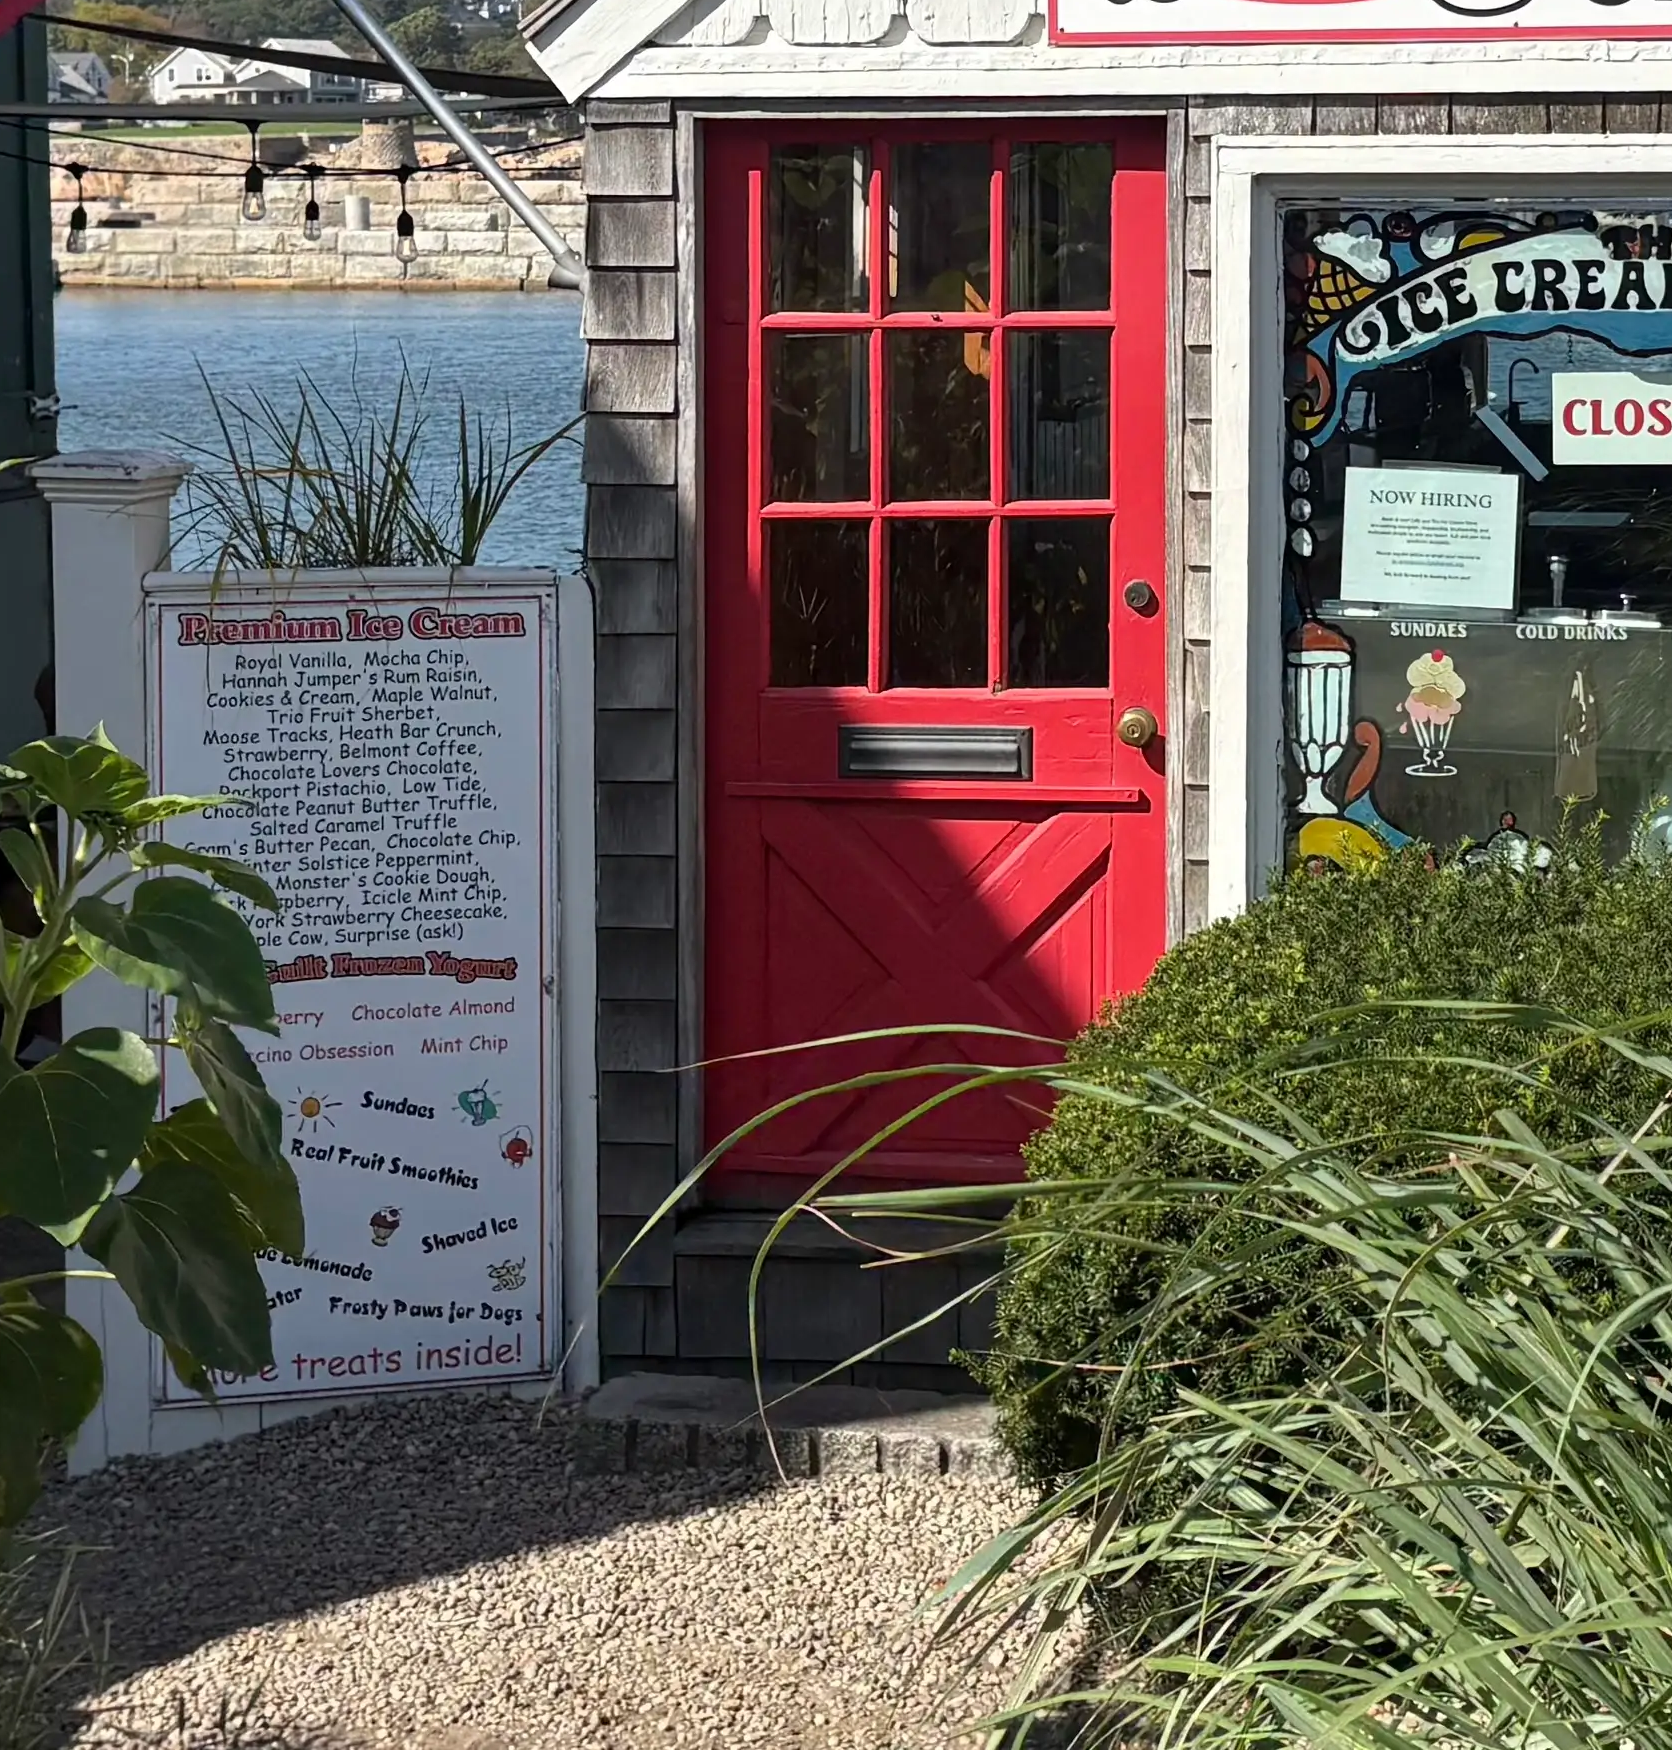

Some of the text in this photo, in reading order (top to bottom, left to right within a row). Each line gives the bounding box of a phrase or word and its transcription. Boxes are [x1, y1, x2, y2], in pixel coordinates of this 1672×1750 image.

[1372, 265, 1479, 350] ICE
[1369, 489, 1493, 509] NOW HIRING
[178, 606, 526, 646] Premium Ice Cream
[1389, 621, 1468, 639] SUNDAES
[1515, 624, 1628, 641] COLD DRINKS
[235, 649, 470, 674] Royal Vanilla, Mocha Chip,
[222, 667, 483, 690] Hannah Jumper's Rum Raisin,
[207, 685, 498, 708] Cookies & Cream, Maple Walnut,
[267, 705, 441, 725] Trio Fruit Sherbet,
[203, 720, 502, 746] Moose Tracks, Heath Bar Crunch,
[223, 739, 483, 764] Strawberry, Belmont Coffee,
[228, 758, 478, 781] Chocolate Lovers Chocolate,
[306, 778, 391, 797] Pistachio,
[403, 778, 436, 794] Low
[442, 776, 487, 793] Tide,
[296, 800, 355, 817] Peanut
[362, 798, 420, 814] Butter
[427, 793, 497, 811] Truffle,
[250, 812, 458, 836] Salted Caramel Truffle
[255, 838, 314, 855] Butter
[320, 835, 376, 853] Pecan,
[386, 832, 473, 850] Chocolate
[478, 829, 521, 849] Chip,
[244, 850, 479, 873] inter Solstice Peppermint,
[275, 866, 495, 891] Monster's Cookie Dough,
[361, 888, 412, 906] Icicle
[418, 887, 459, 903] Mint
[464, 883, 507, 903] Chip,
[291, 907, 395, 928] Strawberry
[401, 903, 508, 922] Cheesecake,
[288, 930, 329, 947] Cow,
[334, 926, 411, 947] Surprise
[416, 922, 464, 943] (ask!)
[331, 951, 426, 978] Frozen
[425, 950, 519, 984] Yogurt
[351, 996, 516, 1022] Chocolate Almond
[299, 1040, 395, 1061] Obsession
[420, 1037, 464, 1055] Mint
[469, 1034, 509, 1054] Chip
[360, 1090, 436, 1121] Sundaes
[290, 1137, 480, 1191] Real Fruit Smoothies
[421, 1214, 519, 1255] Shaved Ice
[267, 1287, 524, 1327] ater Frosty Paws for Dogs
[290, 1347, 402, 1381] treats
[416, 1331, 524, 1372] inside!
